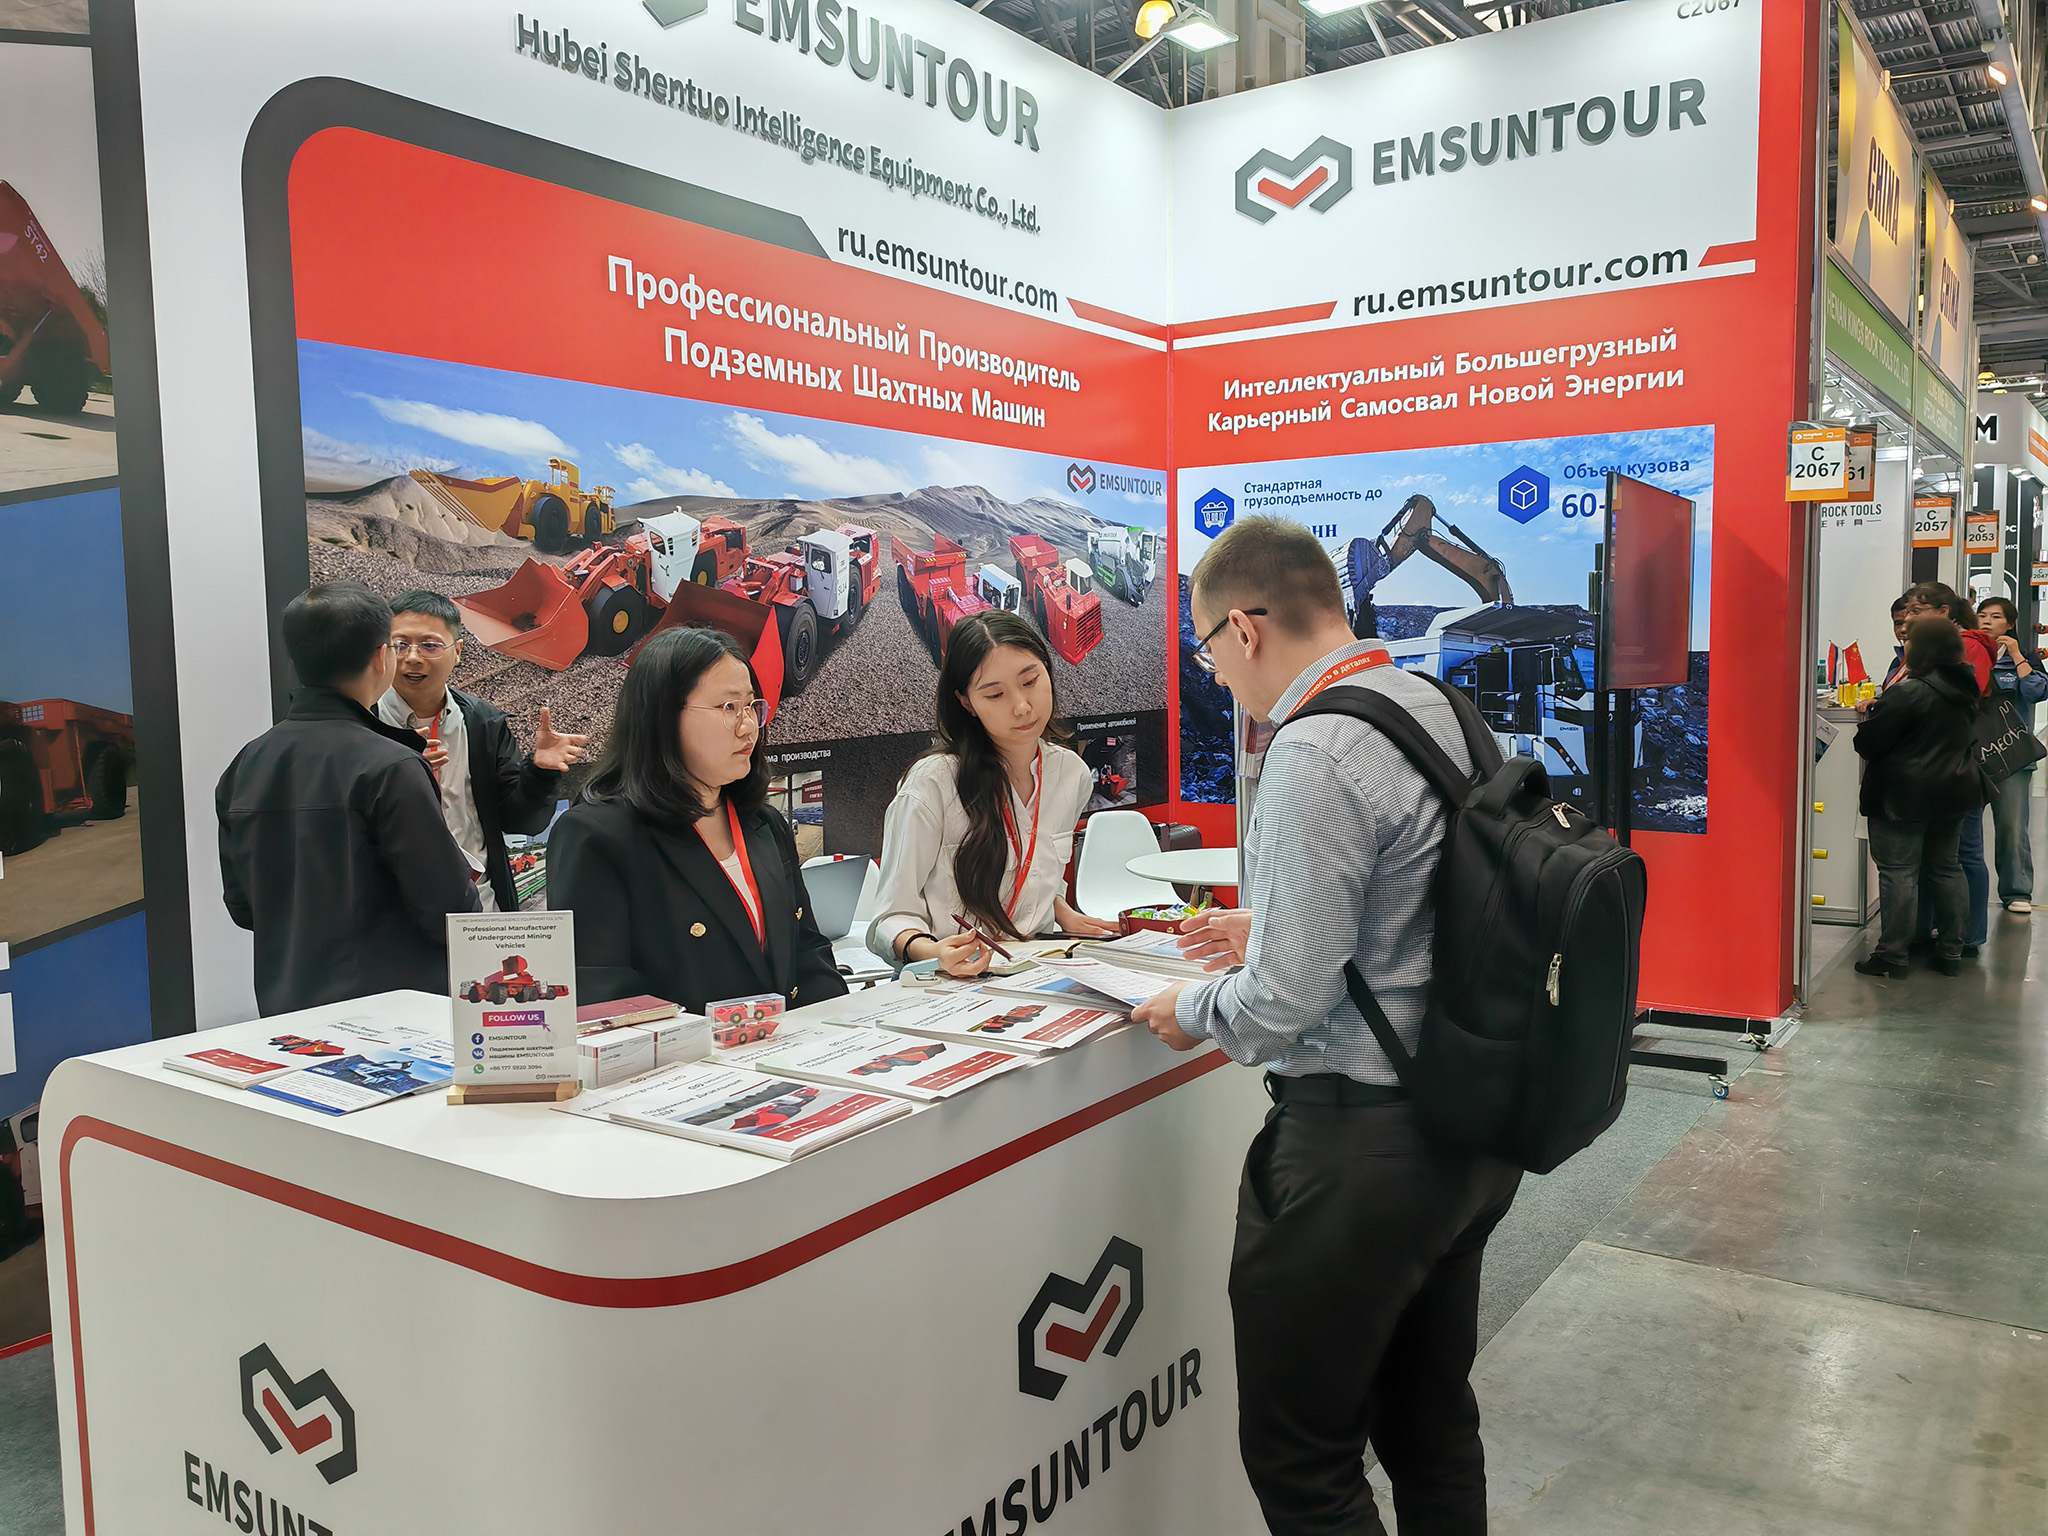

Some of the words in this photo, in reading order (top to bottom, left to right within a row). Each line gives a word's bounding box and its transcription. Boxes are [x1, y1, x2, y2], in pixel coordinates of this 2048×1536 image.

[517, 13, 608, 81] Hubei
[614, 51, 729, 124] Shentuo
[735, 95, 865, 169] Intelligence
[870, 145, 972, 207] Equipment
[976, 186, 1008, 223] Co.,
[1011, 198, 1041, 232] Ltd.
[1373, 78, 1707, 187] EMSUNTOUR
[1868, 136, 1900, 246] CHINA
[838, 226, 1057, 313] ru.emsuntour.com
[1353, 248, 1688, 318] ru.emsuntour.com
[607, 254, 909, 355] Профессиональный
[919, 328, 1081, 393] Производитель
[1224, 354, 1445, 400] Интеллектуальный
[1456, 327, 1677, 374] Большегрузный
[664, 326, 843, 392] Подземных
[853, 364, 963, 414] Шахтных
[971, 387, 1045, 428] Машин
[1208, 400, 1331, 435] Карьерный
[1341, 392, 1458, 419] Самосвал
[1469, 376, 1554, 407] Новой
[1565, 369, 1684, 399] Энергии
[1811, 446, 1825, 461] C
[1563, 463, 1622, 479] Объем
[1627, 459, 1690, 478] кузова
[1795, 461, 1840, 478] 2067
[1849, 466, 1865, 481] 61
[1100, 473, 1162, 496] EMSUNTOUR
[1244, 479, 1322, 494] Стандартная
[1244, 489, 1361, 509] грузоподъемность
[1365, 488, 1383, 501] до
[1822, 506, 1847, 517] ROCK
[1850, 503, 1882, 516] TOOLS
[1927, 510, 1937, 520] C
[1304, 524, 1337, 538] нн
[1915, 521, 1948, 532] 2057
[1978, 524, 1986, 533] C
[1968, 533, 1995, 542] 2053
[1340, 656, 1371, 674] деталях
[1980, 726, 2028, 764] MEOW
[781, 749, 831, 763] производства
[463, 925, 507, 933] Professional
[477, 933, 526, 942] Underground
[527, 932, 552, 940] Mining
[488, 1014, 526, 1022] FOLLOW
[527, 1013, 540, 1021] US
[943, 1347, 1203, 1536] MSUNTOUR
